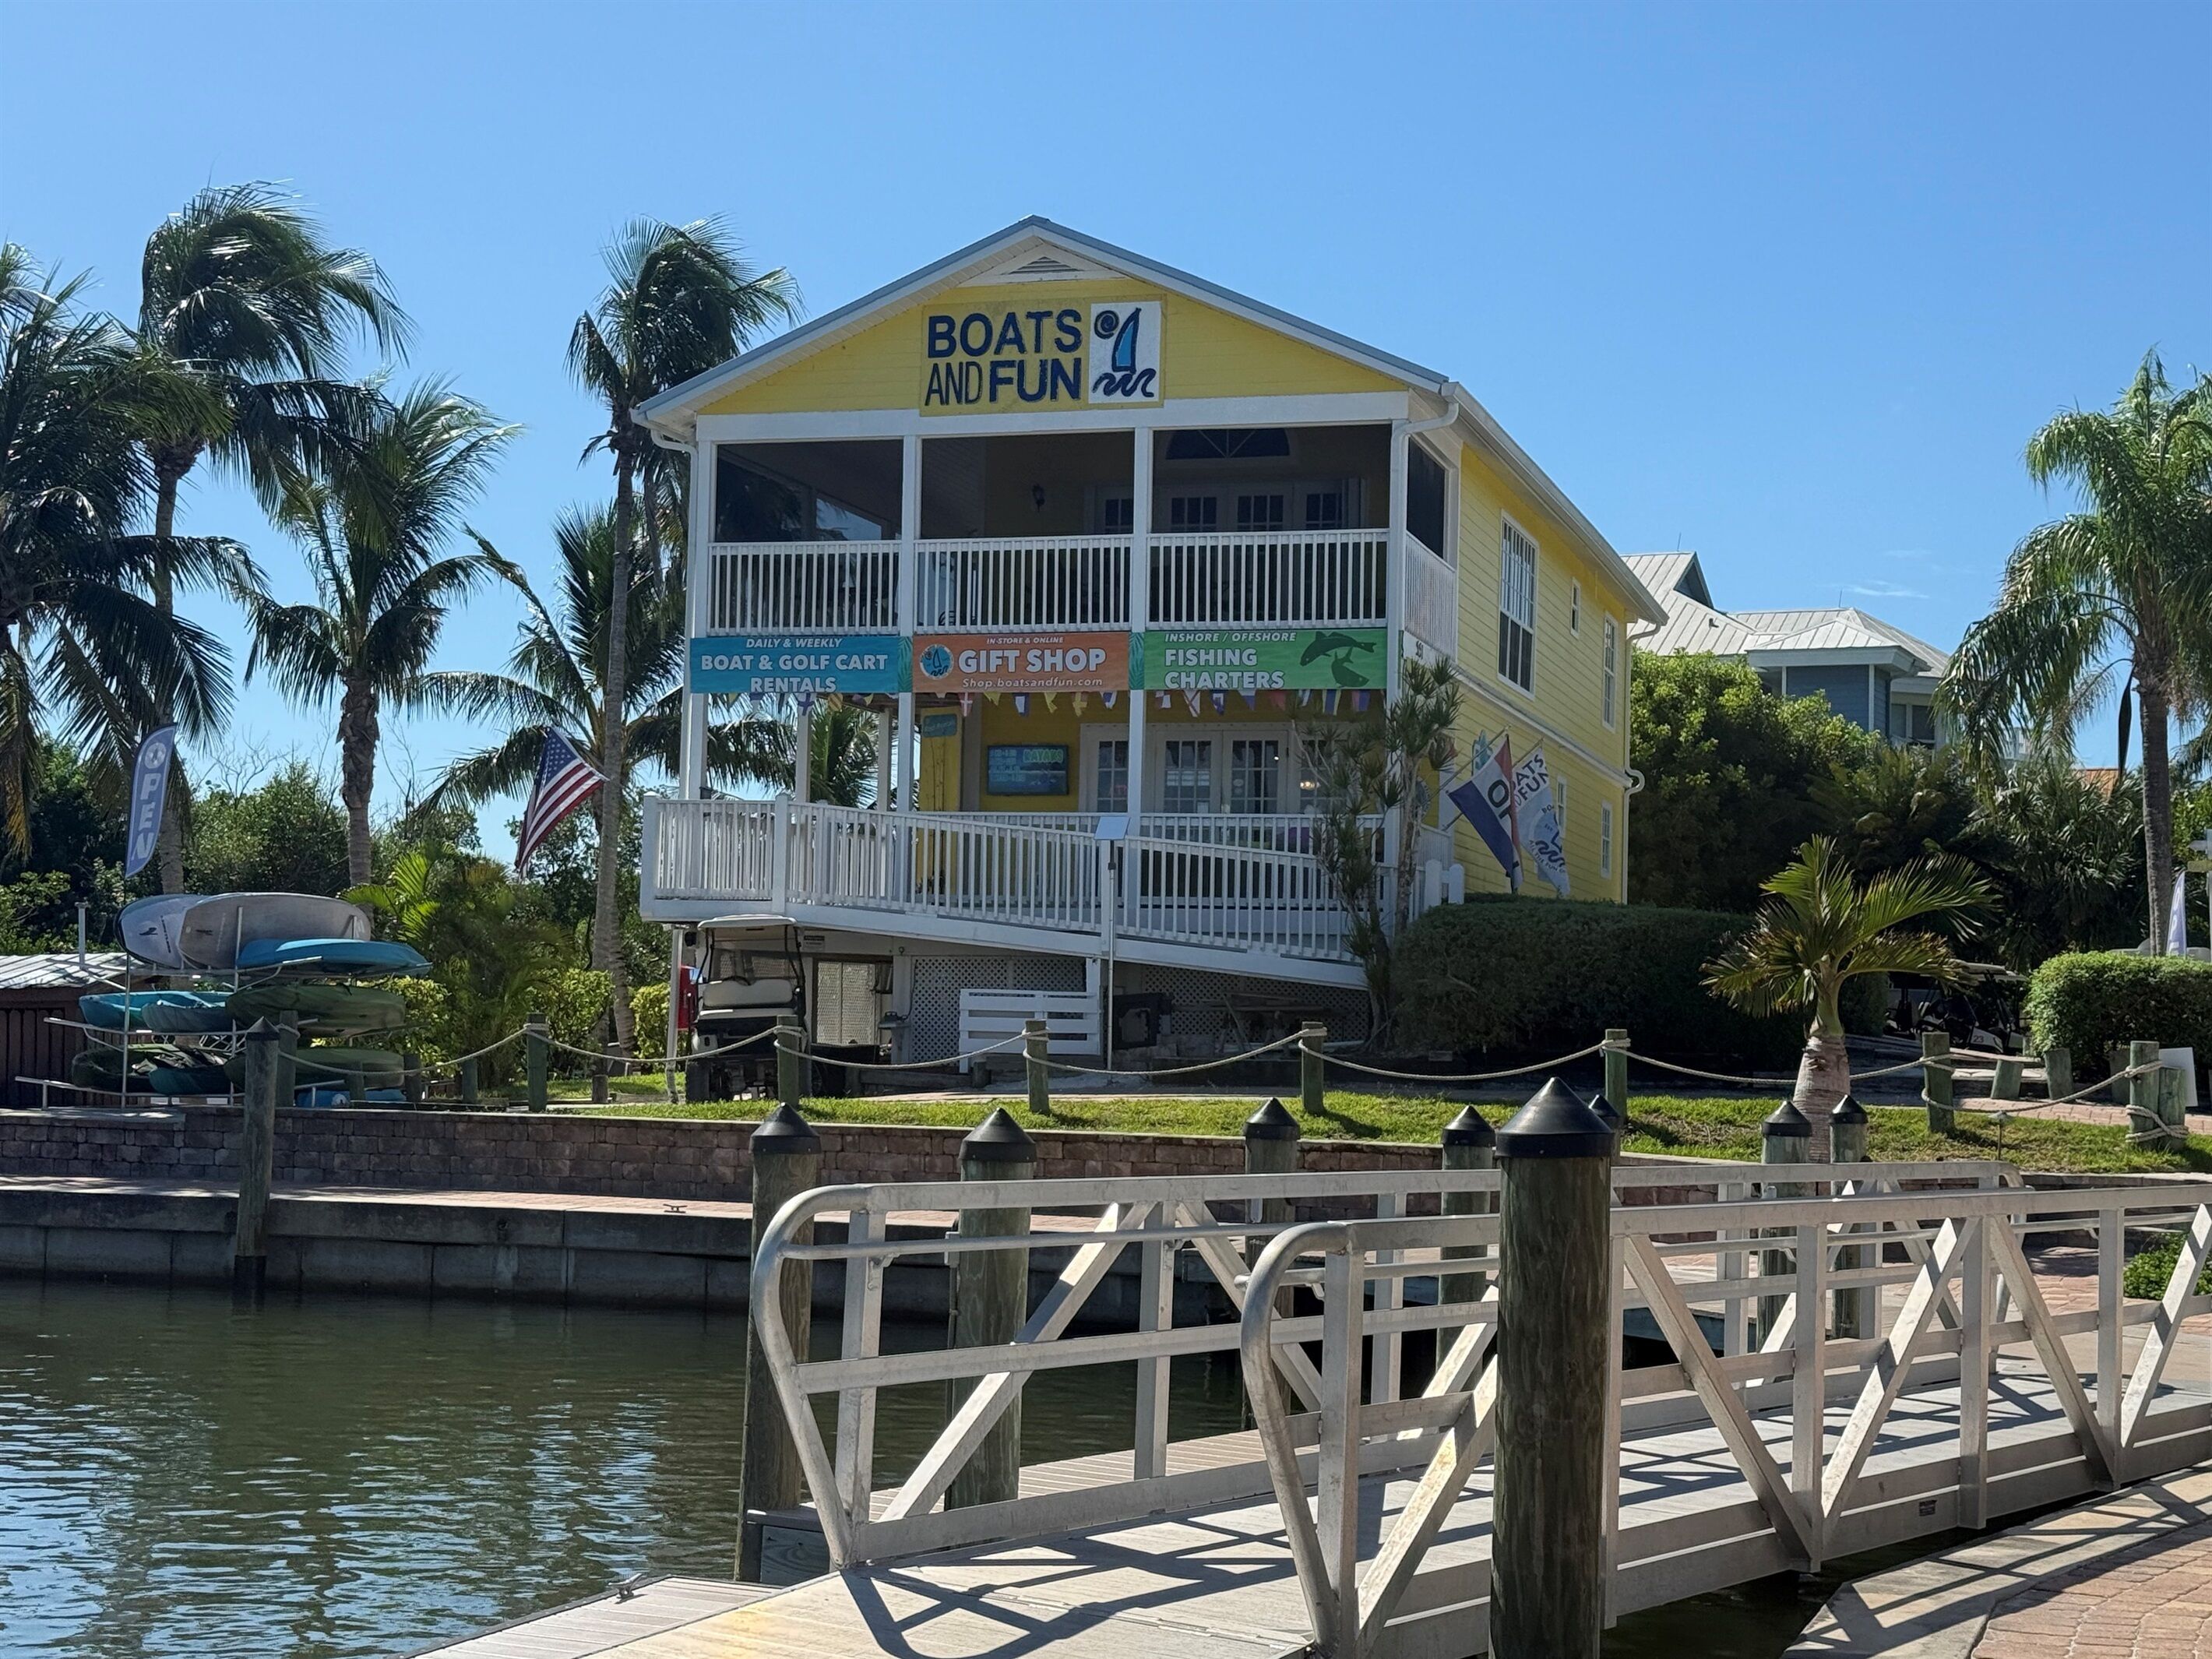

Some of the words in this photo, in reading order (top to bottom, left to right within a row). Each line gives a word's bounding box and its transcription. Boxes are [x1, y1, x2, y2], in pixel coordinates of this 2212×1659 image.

[928, 308, 1083, 358] BOATS
[925, 361, 983, 407] AND
[989, 358, 1082, 403] FUN
[745, 638, 780, 648] DAILY
[783, 638, 792, 648] &
[795, 638, 843, 648] WEEKLY
[1164, 632, 1220, 643] INSHORE
[1222, 632, 1228, 643] /
[1231, 632, 1296, 642] OFFSHORE
[701, 655, 754, 671] BOAT
[758, 655, 773, 671] &
[779, 654, 830, 671] GOLF
[835, 654, 888, 670] CART
[958, 650, 1020, 674] GIFT
[1026, 648, 1106, 673] SHOP
[1164, 648, 1258, 667] FISHING
[750, 677, 837, 692] RENTALS
[963, 677, 1103, 689] Shop.boatsandfun.com
[1164, 671, 1284, 689] CHARTERS
[1512, 754, 1545, 791] ATS
[131, 741, 167, 861] OPEN
